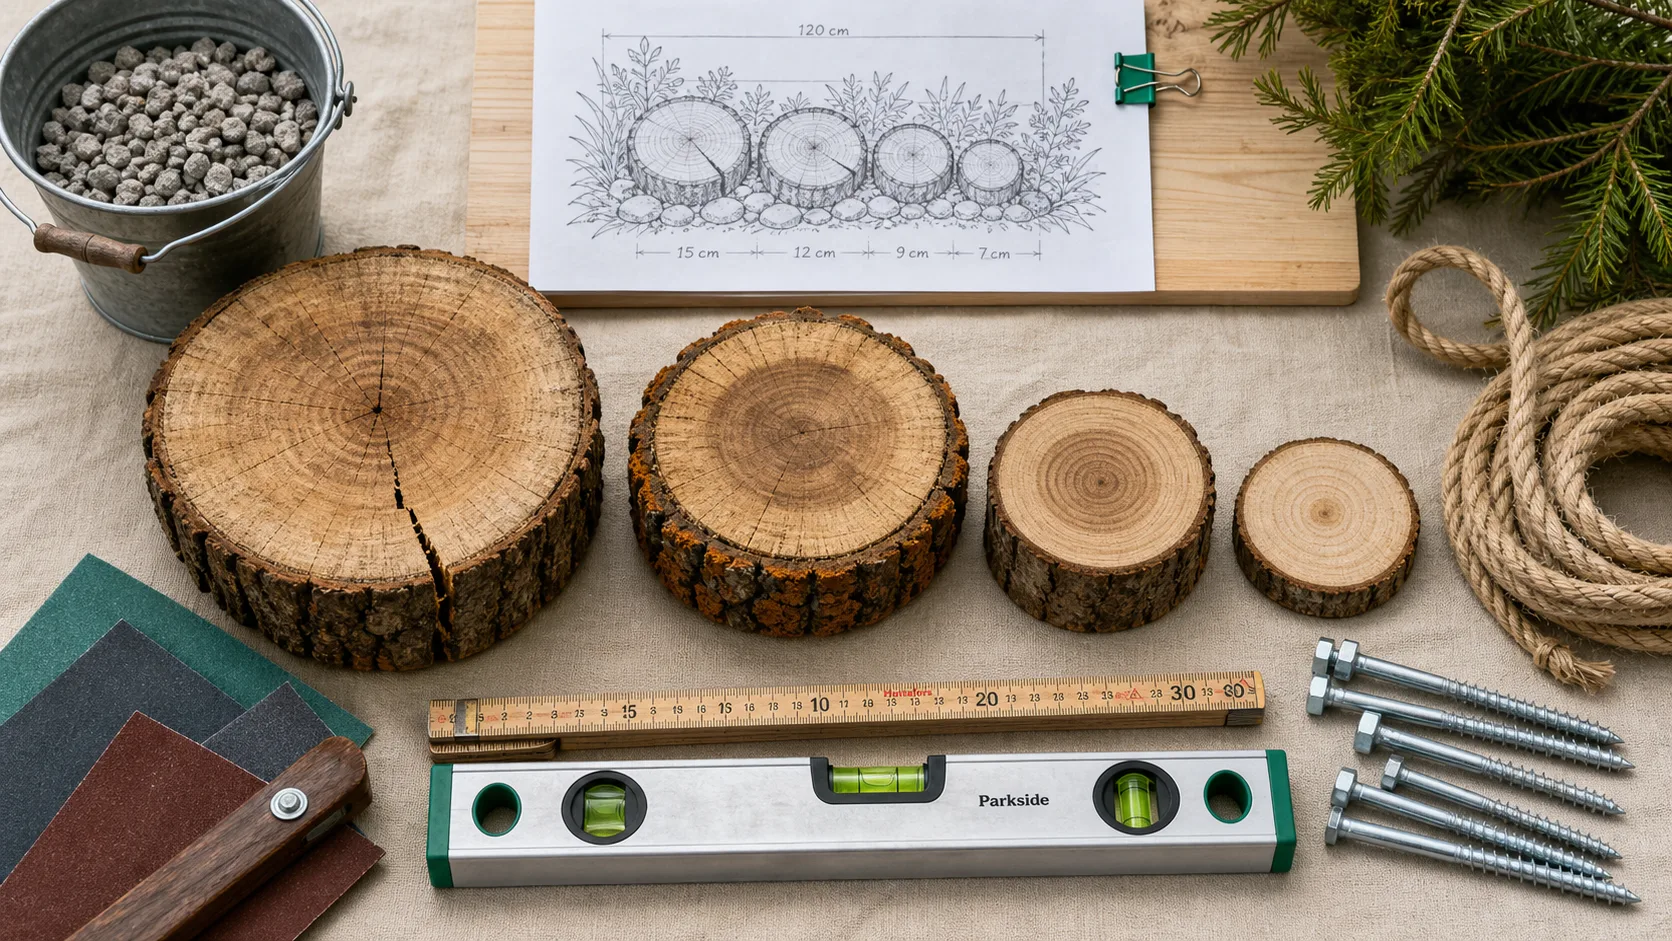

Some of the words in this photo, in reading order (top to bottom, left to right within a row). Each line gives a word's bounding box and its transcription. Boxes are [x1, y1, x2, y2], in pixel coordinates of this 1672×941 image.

[798, 23, 825, 36] 120
[828, 27, 849, 36] cm
[677, 246, 694, 259] 15
[698, 249, 720, 259] cm
[793, 246, 811, 259] 12
[815, 249, 836, 259] cm
[896, 246, 906, 259] 9
[908, 249, 929, 259] cm
[978, 247, 988, 260] 7
[990, 250, 1011, 260] cm
[810, 697, 830, 712] 10
[975, 691, 999, 707] 20
[1170, 685, 1196, 701] 30
[979, 793, 1050, 807] Parkside
